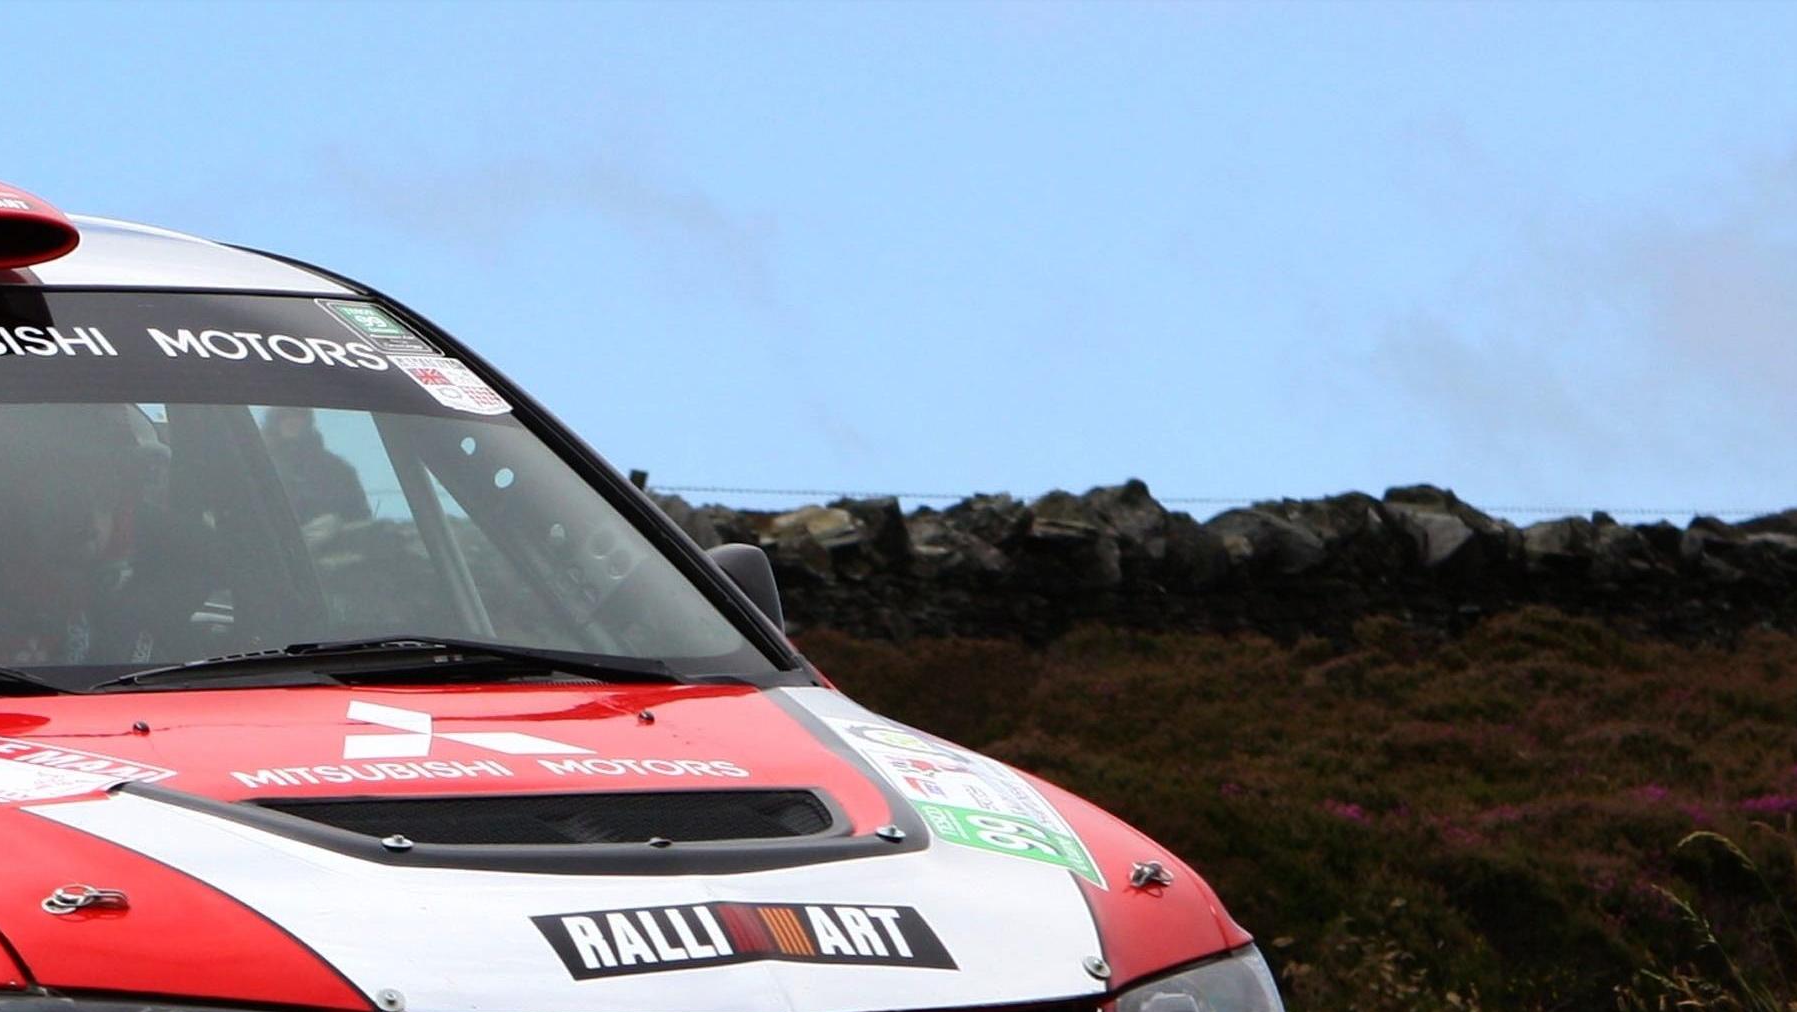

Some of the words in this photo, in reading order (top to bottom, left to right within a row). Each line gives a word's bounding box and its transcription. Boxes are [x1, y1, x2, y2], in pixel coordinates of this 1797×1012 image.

[146, 327, 389, 371] MOTORS
[16, 749, 161, 784] MAN
[230, 758, 515, 789] MITSUBISHI
[538, 758, 751, 779] MOTORS
[560, 905, 736, 970] RALLI
[804, 905, 915, 959] ART
